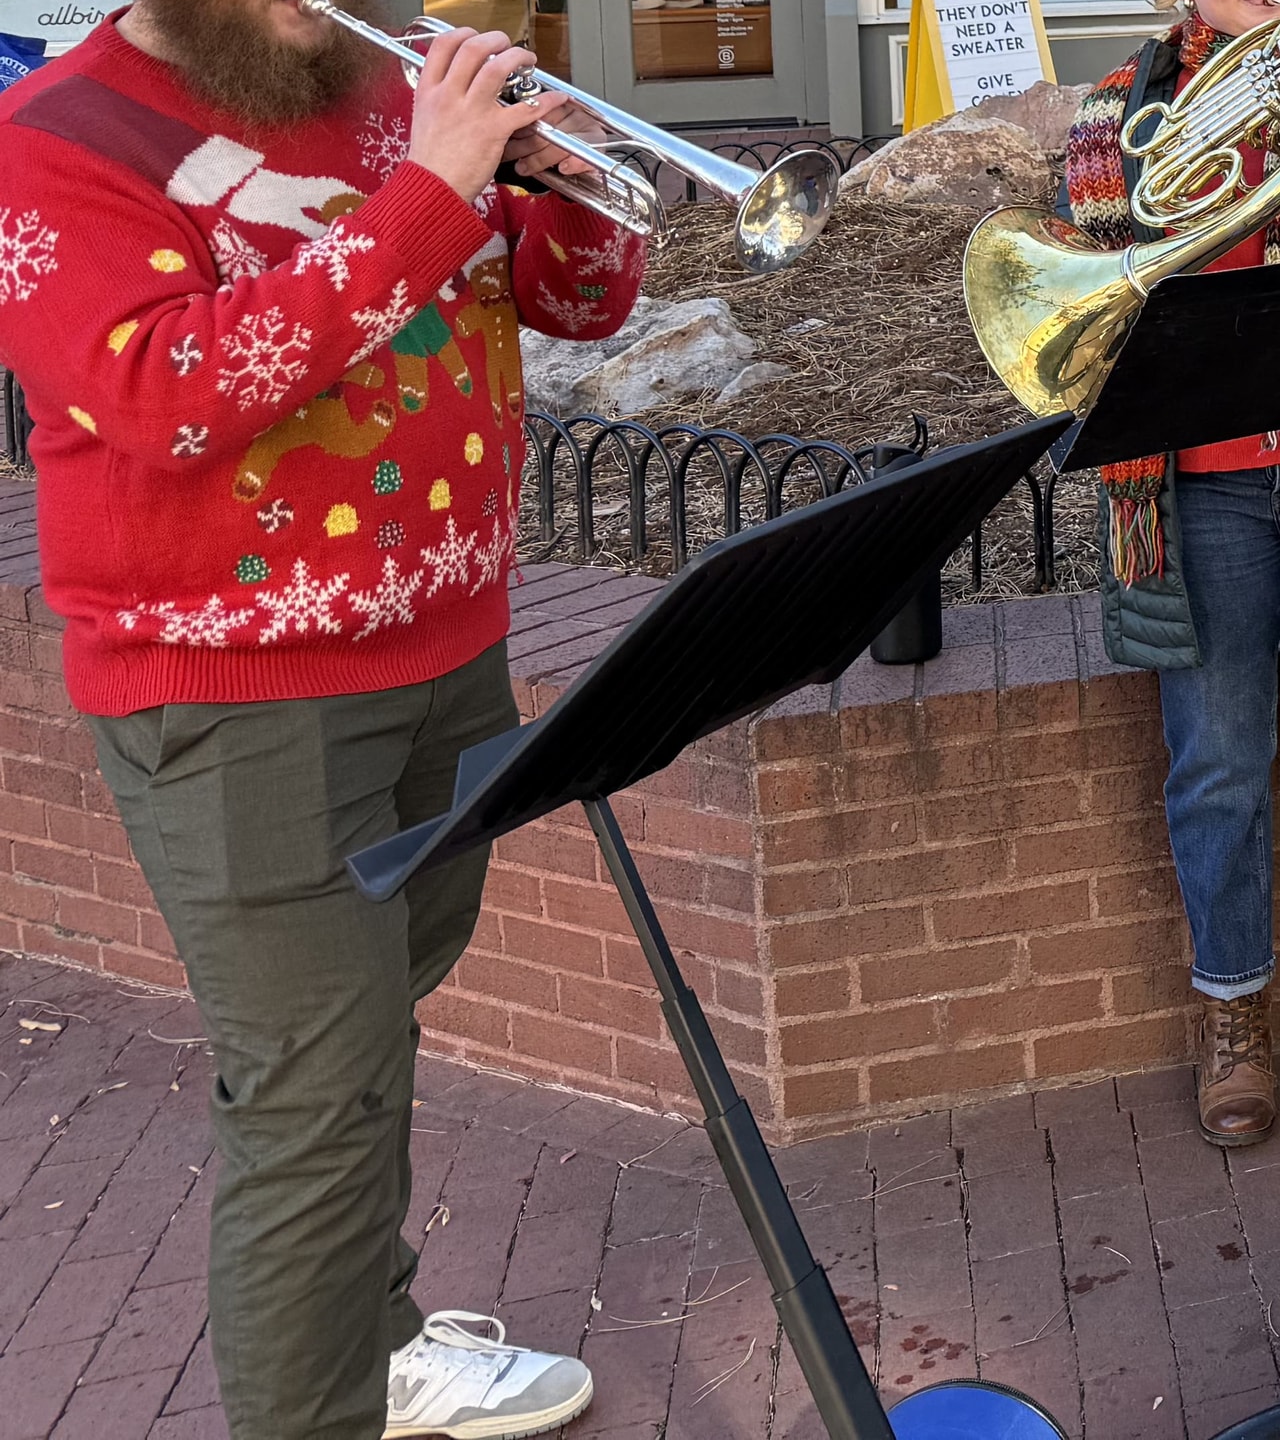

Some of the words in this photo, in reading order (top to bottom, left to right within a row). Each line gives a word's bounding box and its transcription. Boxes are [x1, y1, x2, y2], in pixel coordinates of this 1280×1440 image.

[936, 6, 977, 23] THEY
[982, 1, 1029, 17] DON'T
[956, 22, 997, 38] NEED
[1004, 21, 1015, 33] A
[952, 37, 1025, 57] SWEATER
[977, 73, 1014, 90] GIVE
